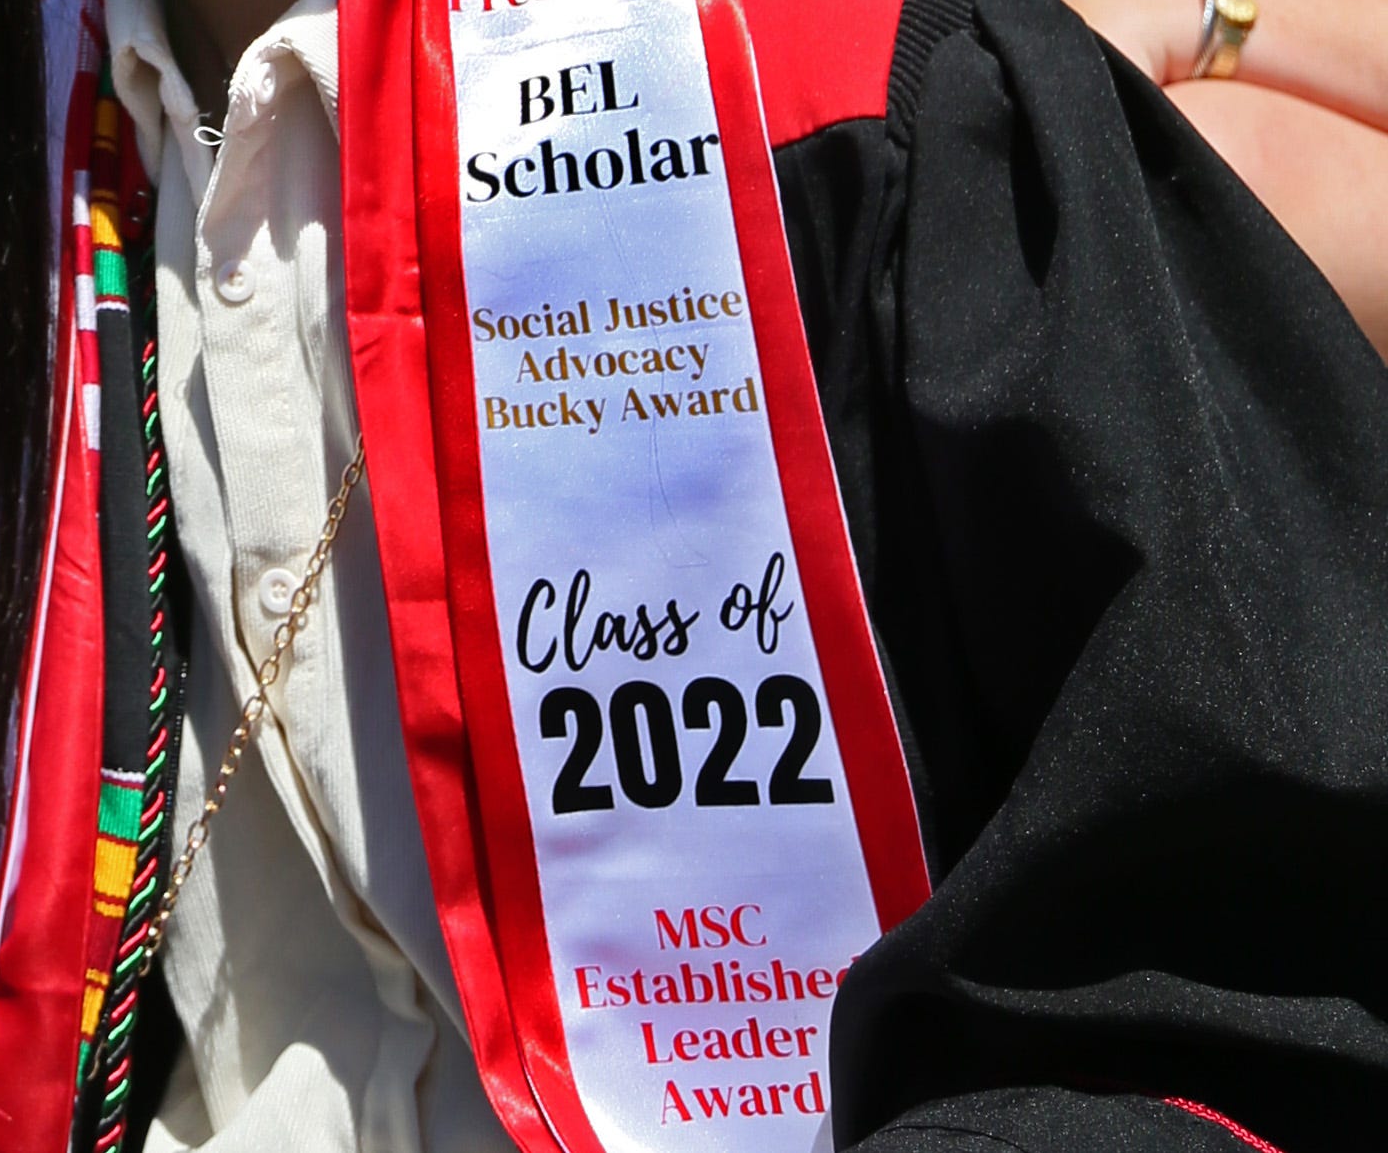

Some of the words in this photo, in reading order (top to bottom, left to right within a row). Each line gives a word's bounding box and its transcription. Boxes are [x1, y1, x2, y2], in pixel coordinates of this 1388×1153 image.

[518, 59, 639, 126] BEL
[465, 128, 719, 203] Scholar
[472, 300, 591, 343] Social
[604, 286, 743, 333] Justice
[515, 341, 710, 384] Advocacy
[483, 392, 607, 435] Bucky
[620, 377, 760, 422] Award
[516, 568, 700, 674] Class
[719, 551, 795, 655] of
[539, 673, 835, 815] 2022
[654, 904, 767, 950] MSC
[640, 1016, 818, 1065] Leader
[660, 1070, 826, 1126] Award
